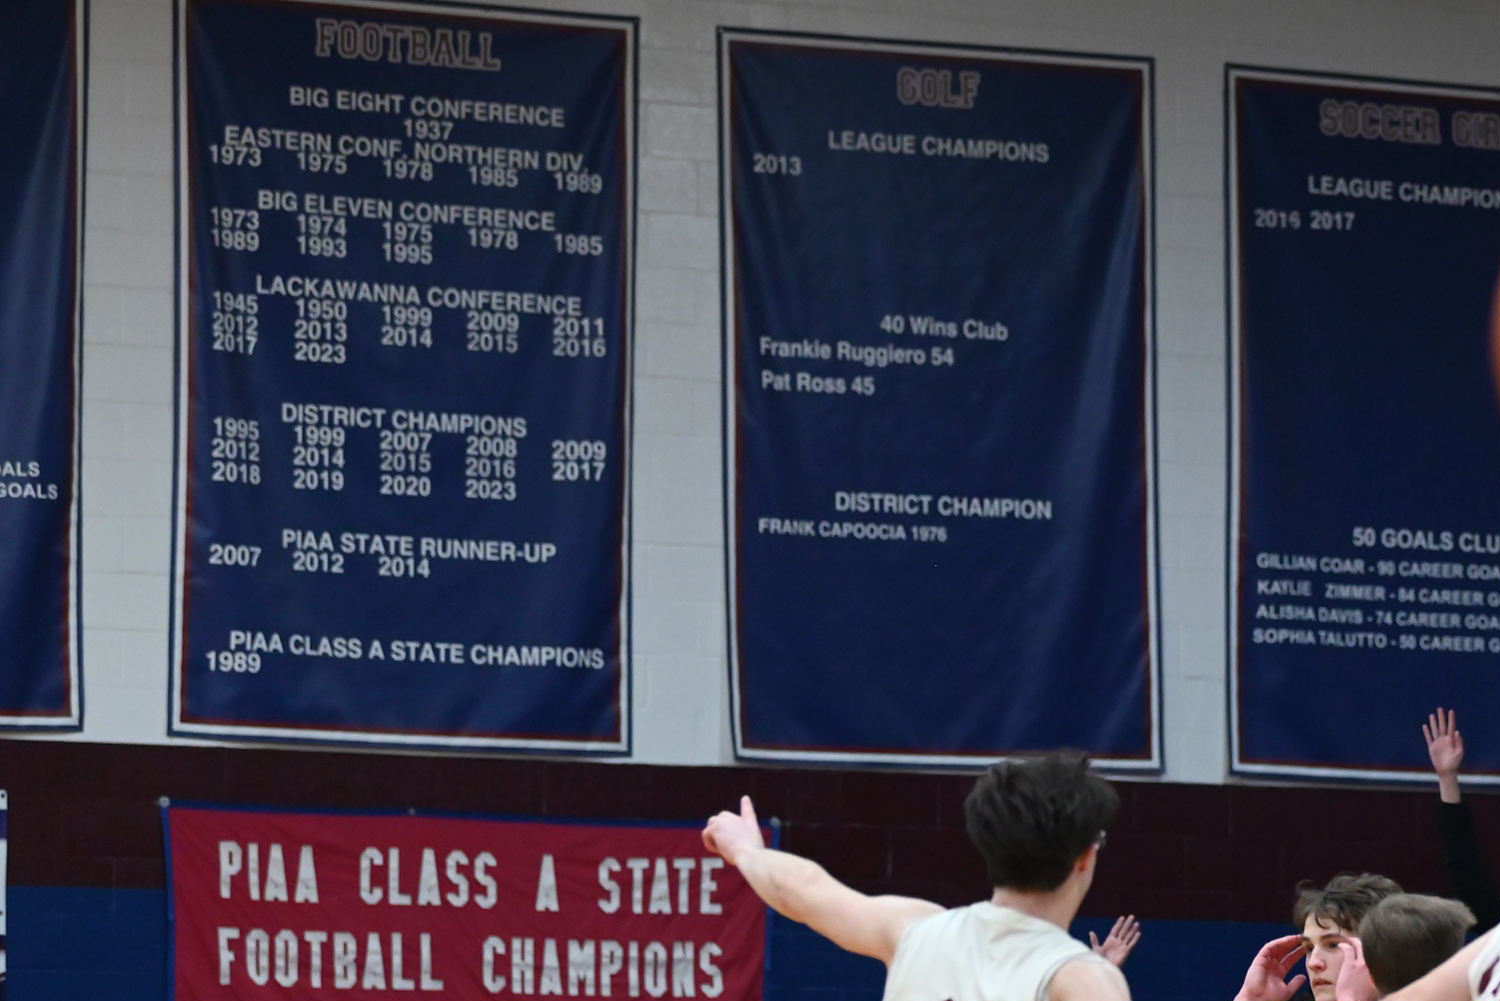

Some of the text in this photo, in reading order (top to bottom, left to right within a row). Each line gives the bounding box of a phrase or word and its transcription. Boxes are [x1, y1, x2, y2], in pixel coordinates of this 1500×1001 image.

[315, 18, 501, 71] FOOTBALL
[897, 67, 980, 109] GOLF
[290, 87, 564, 129] BIG EIGHT CONFERENCE
[1320, 99, 1441, 144] SOCCER
[404, 119, 453, 140] 1937
[224, 125, 333, 156] EASTERN
[412, 141, 539, 169] NORTHERN
[829, 131, 1049, 162] LEAGUE CHAMPIONS
[210, 144, 602, 193] 1973 1975 1978 1985 1989
[754, 153, 801, 175] 2013
[1308, 176, 1392, 200] LEAGUE
[258, 190, 555, 233] BIG ELEVEN CONFERENCE
[1255, 209, 1355, 230] 2016 2017
[212, 208, 603, 255] 1973 1974 1975 1978 1985
[213, 229, 432, 264] 1989 1993 1995
[257, 275, 581, 317] LACKAWANNA CONFERENCE
[214, 292, 604, 337] 1945 1950 1999 2009 2011
[880, 315, 1008, 340] 40 Wins Club
[213, 312, 606, 357] 2012 2013 2014 2015 2016
[213, 333, 346, 363] 2017 2023
[760, 337, 954, 367] Frankie Ruggiero 54
[762, 370, 875, 395] Pat Ross 45
[282, 403, 527, 438] DISTRICT CHAMPIONS
[214, 417, 605, 462] 1995 1999 2007 2008 2009
[0, 461, 41, 478] ALS
[212, 438, 605, 481] 2012 2014 2015 2016 2017
[212, 461, 516, 500] 2018 2019 2020 2023
[835, 492, 1052, 519] DISTRICT CHAMPION
[759, 518, 815, 536] FRANK
[1353, 527, 1375, 546] 50
[1381, 528, 1453, 551] GOALS
[209, 545, 430, 578] 2007 2012 2014
[283, 529, 556, 562] PIAA STATE RUNNER-UP
[1399, 561, 1463, 578] CAREER
[1419, 589, 1484, 605] CAREER
[1318, 607, 1363, 624] DAVIS
[1396, 612, 1460, 628] CAREER
[230, 631, 604, 669] PIAA CLASS A STATE CHAMPIONS
[1253, 628, 1315, 643] SOPHIA
[1318, 630, 1387, 648] TALUTTO
[1420, 635, 1484, 651] CAREER
[207, 651, 260, 673] 1989
[219, 841, 724, 914] PIAA CLASS A STATE
[218, 927, 723, 998] FOOTBALL CHAMPIONS
